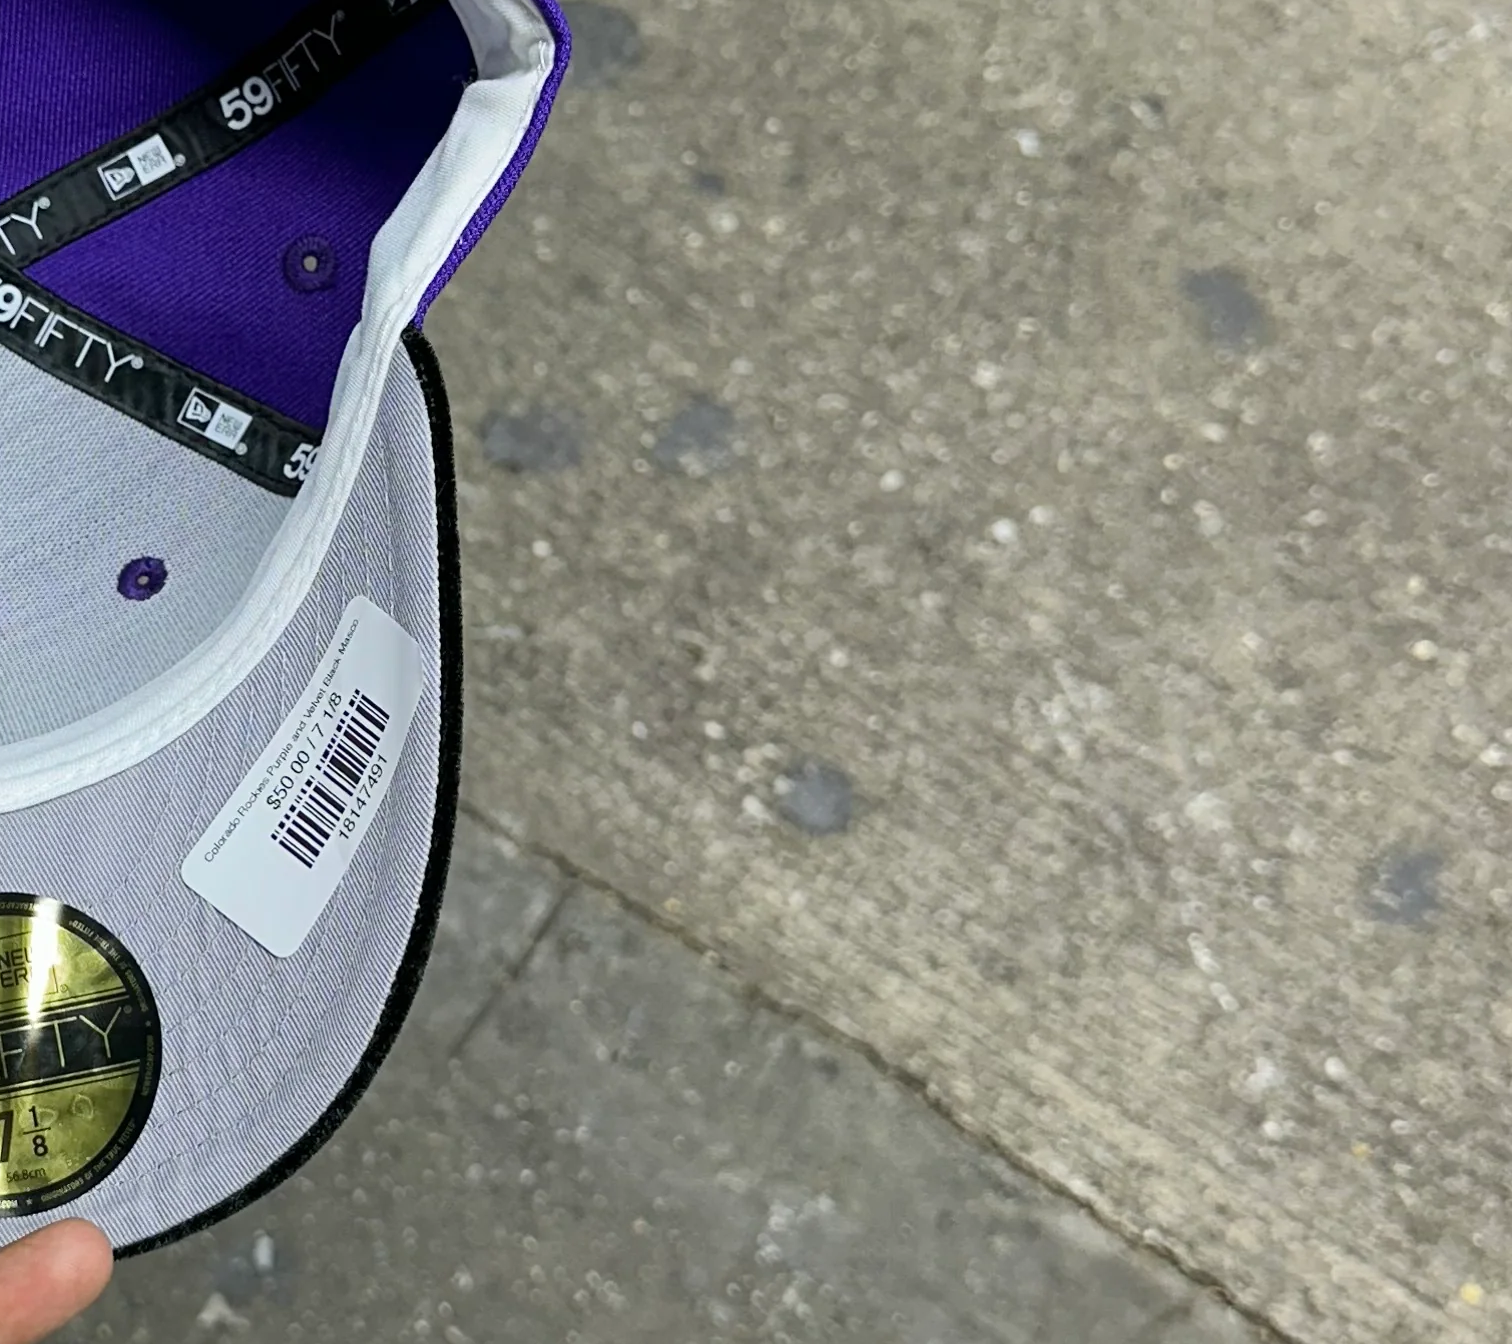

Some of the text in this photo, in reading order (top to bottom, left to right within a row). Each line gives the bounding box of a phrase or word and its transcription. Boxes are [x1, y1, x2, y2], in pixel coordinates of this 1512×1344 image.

[311, 722, 324, 737] 7
[323, 692, 342, 719] 1/8
[204, 817, 241, 863] Colorado
[237, 777, 270, 817] Rockies
[266, 742, 293, 776] Purple
[291, 720, 307, 742] and
[303, 688, 327, 719] Velvet
[322, 657, 341, 687] Black
[339, 754, 388, 842] 18147491
[6, 1167, 47, 1183] 56.8cm
